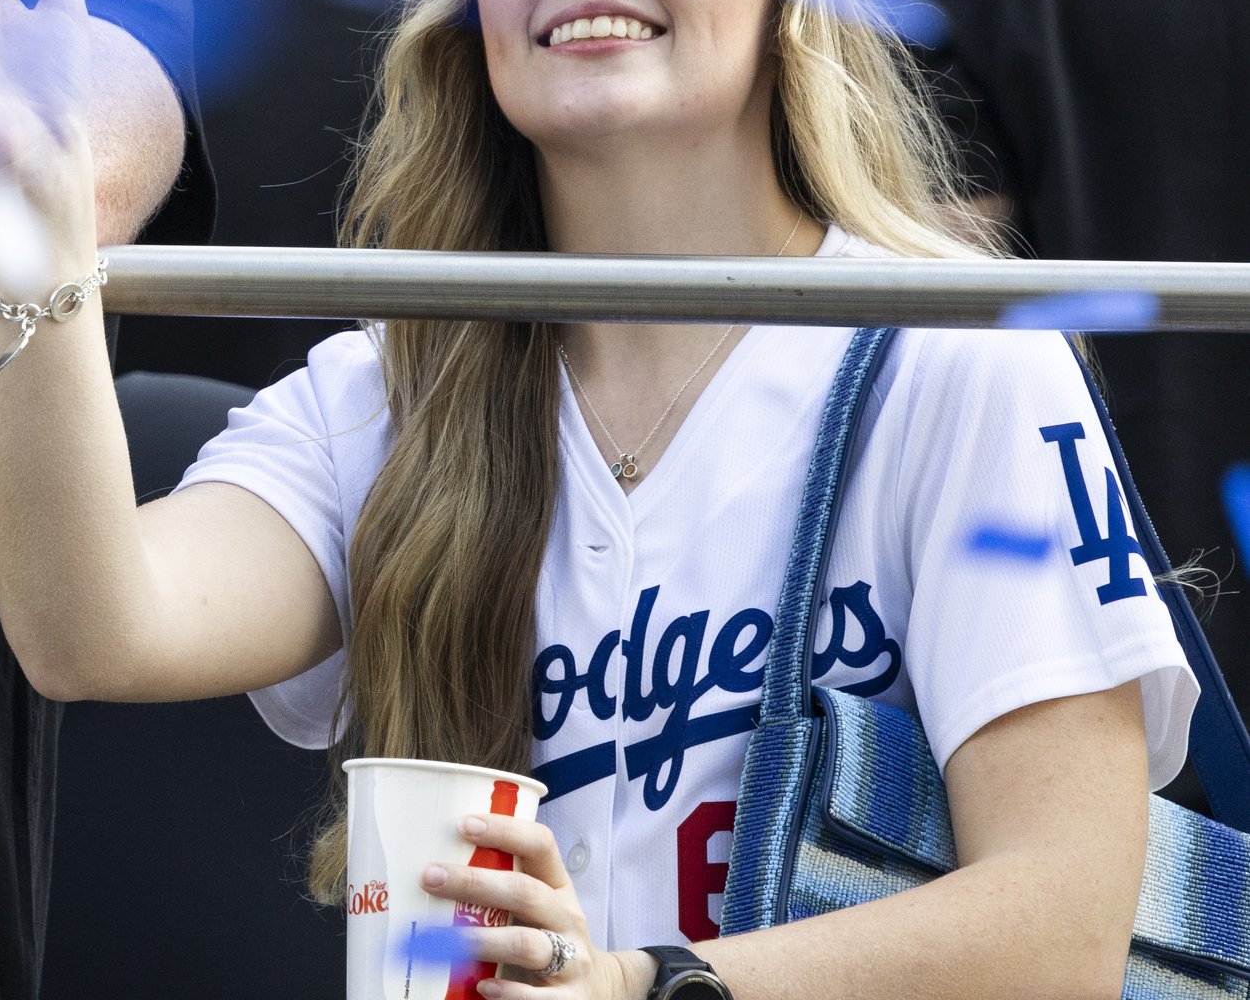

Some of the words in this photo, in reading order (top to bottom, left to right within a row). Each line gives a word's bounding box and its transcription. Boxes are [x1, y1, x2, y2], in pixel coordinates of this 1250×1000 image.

[1039, 422, 1163, 606] LA
[530, 580, 902, 812] odges
[348, 884, 389, 915] Coke
